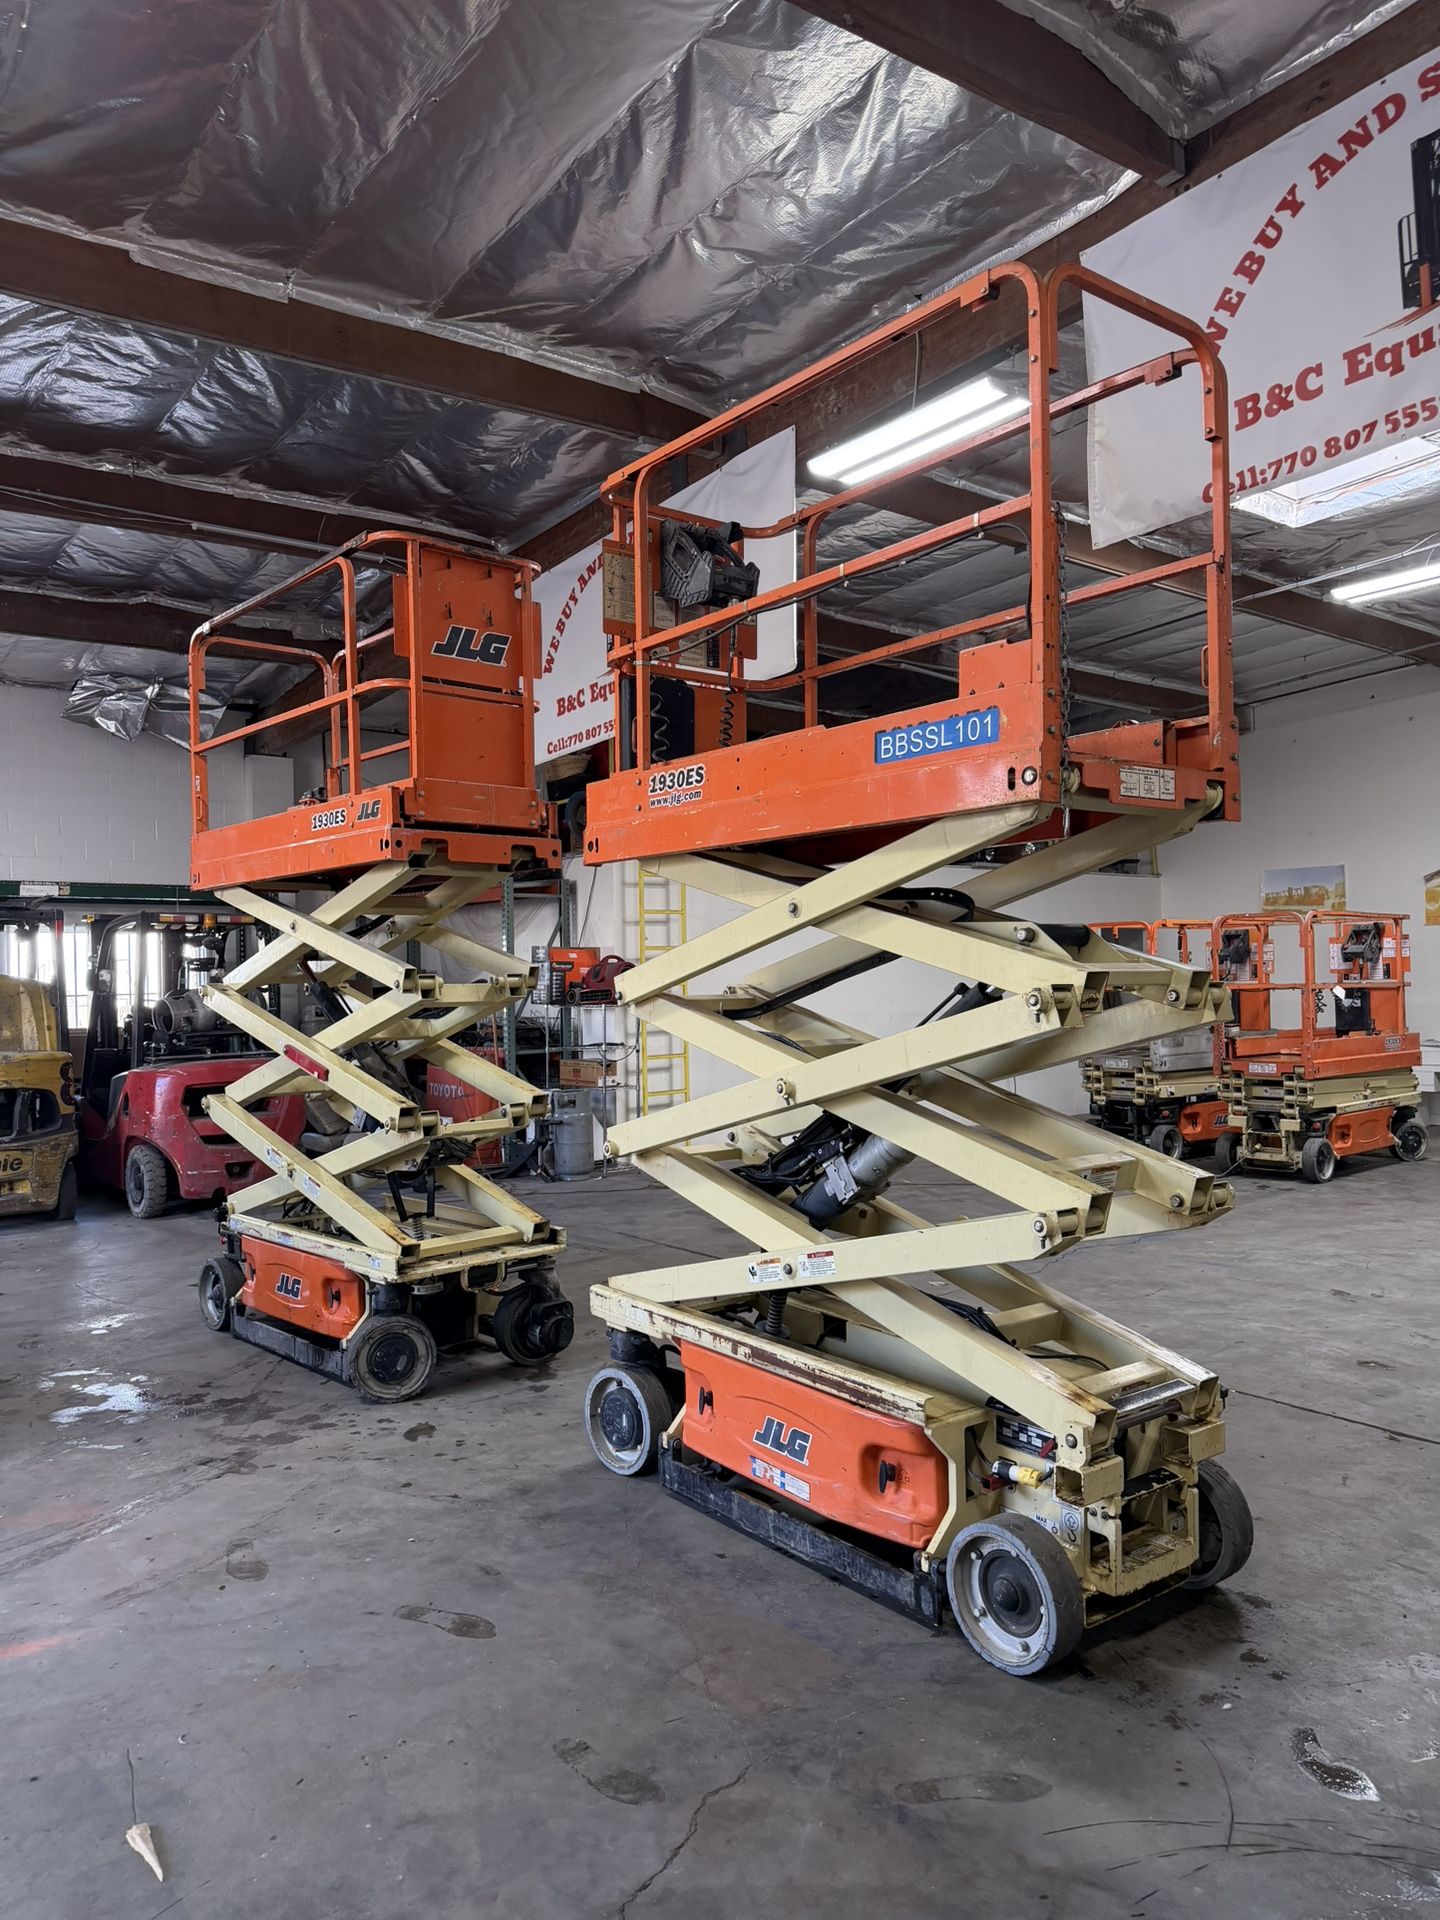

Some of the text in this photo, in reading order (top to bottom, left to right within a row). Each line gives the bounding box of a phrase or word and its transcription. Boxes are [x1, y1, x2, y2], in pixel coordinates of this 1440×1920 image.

[1232, 183, 1306, 285] BUY
[1308, 93, 1407, 190] AND
[1234, 324, 1440, 432] B&C Equ
[1323, 420, 1379, 459] 807
[1384, 396, 1440, 435] 555
[430, 624, 512, 667] JLG
[543, 635, 560, 674] WE
[556, 587, 579, 637] BUY
[556, 687, 586, 717] B&C
[546, 719, 615, 755] Cell:770 807 55
[880, 713, 992, 759] BBSSL 101
[649, 765, 705, 794] 1930ES
[650, 790, 702, 807] www.jlg.com
[312, 808, 347, 830] 1930ES
[356, 799, 382, 821] JLG
[275, 1272, 303, 1300] JLG
[752, 1415, 813, 1465] JLG
